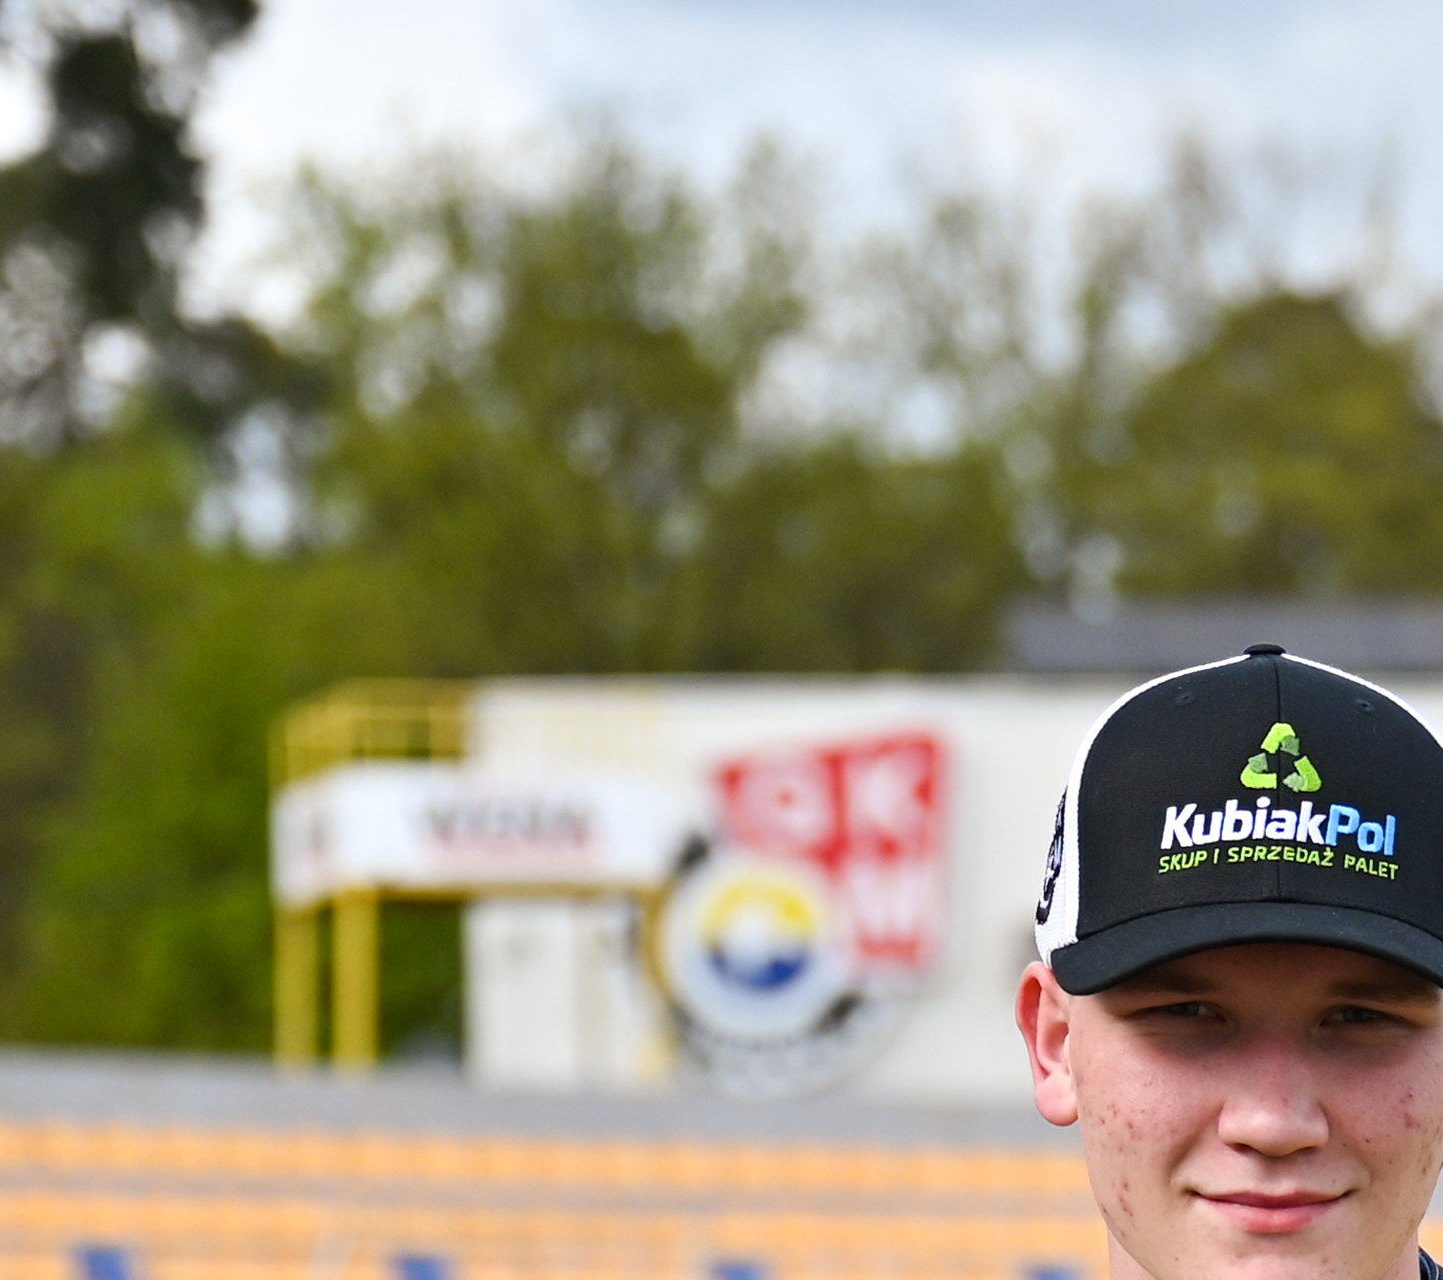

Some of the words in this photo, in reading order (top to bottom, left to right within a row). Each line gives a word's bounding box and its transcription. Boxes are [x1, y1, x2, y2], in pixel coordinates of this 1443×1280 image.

[1160, 797, 1396, 857] KubiakPol
[1158, 849, 1208, 874] SKUP
[1213, 848, 1220, 865] I
[1228, 846, 1335, 869] SPRZEDAŻ
[1344, 855, 1399, 880] PALET
